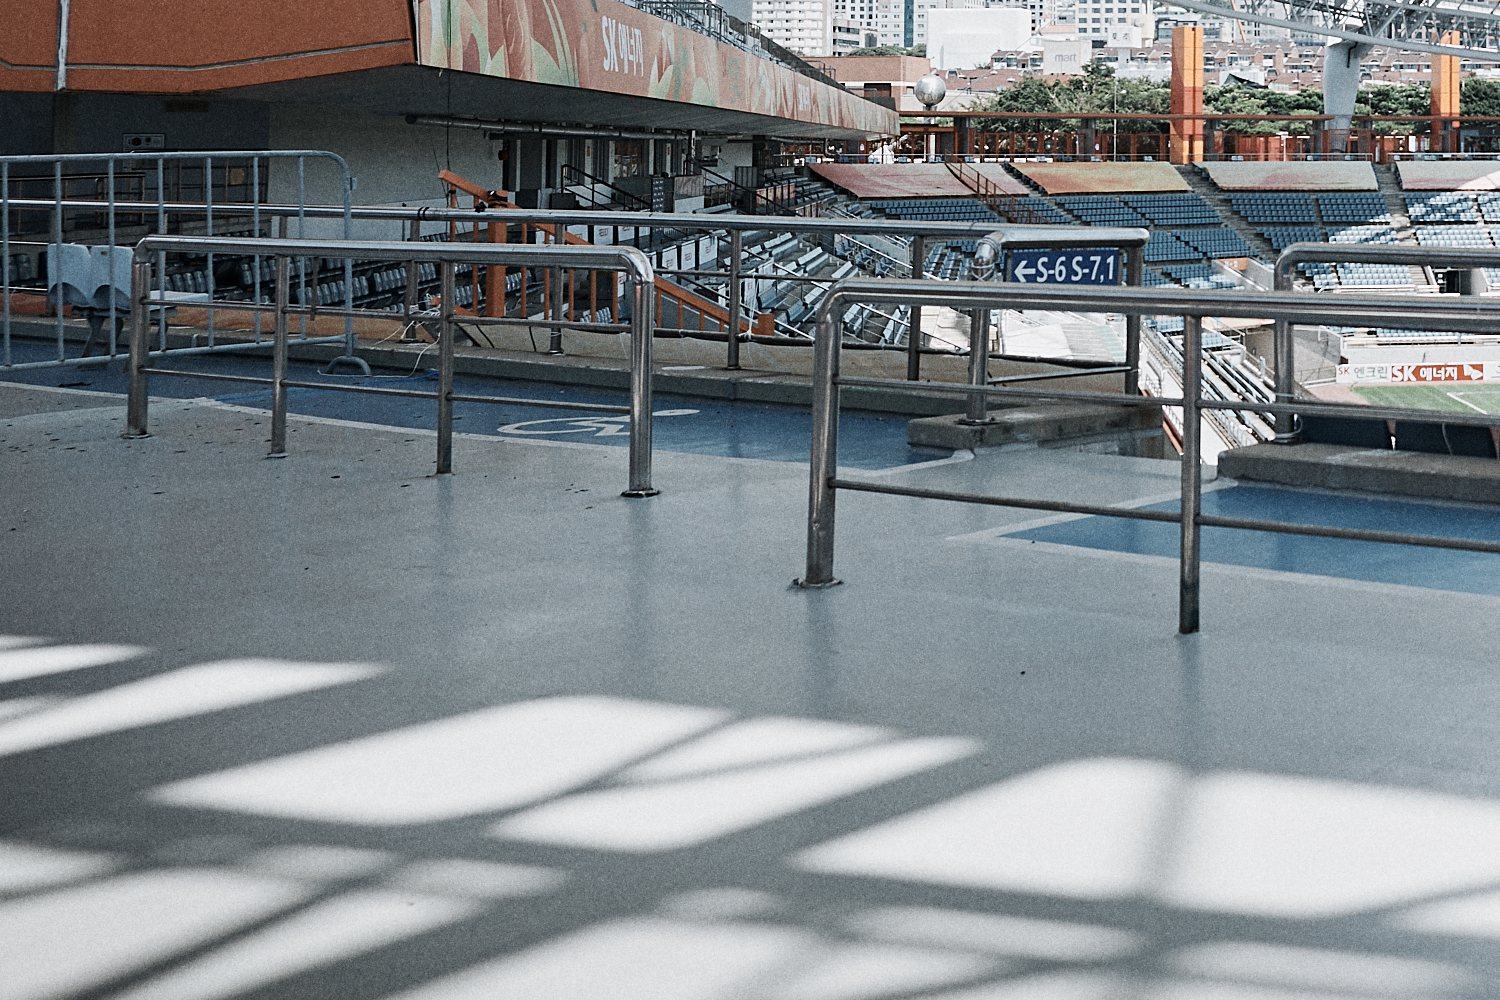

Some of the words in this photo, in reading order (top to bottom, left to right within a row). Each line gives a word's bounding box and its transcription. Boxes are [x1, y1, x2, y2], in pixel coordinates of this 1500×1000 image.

[602, 15, 619, 72] SK
[618, 22, 644, 77] 에너지
[1054, 53, 1077, 62] mart
[1037, 256, 1066, 283] S-6
[1071, 255, 1115, 284] S-7,1
[1338, 366, 1350, 375] SK
[1354, 366, 1388, 379] 엔크린
[1392, 365, 1417, 382] SK
[1420, 366, 1458, 381] 에너지
